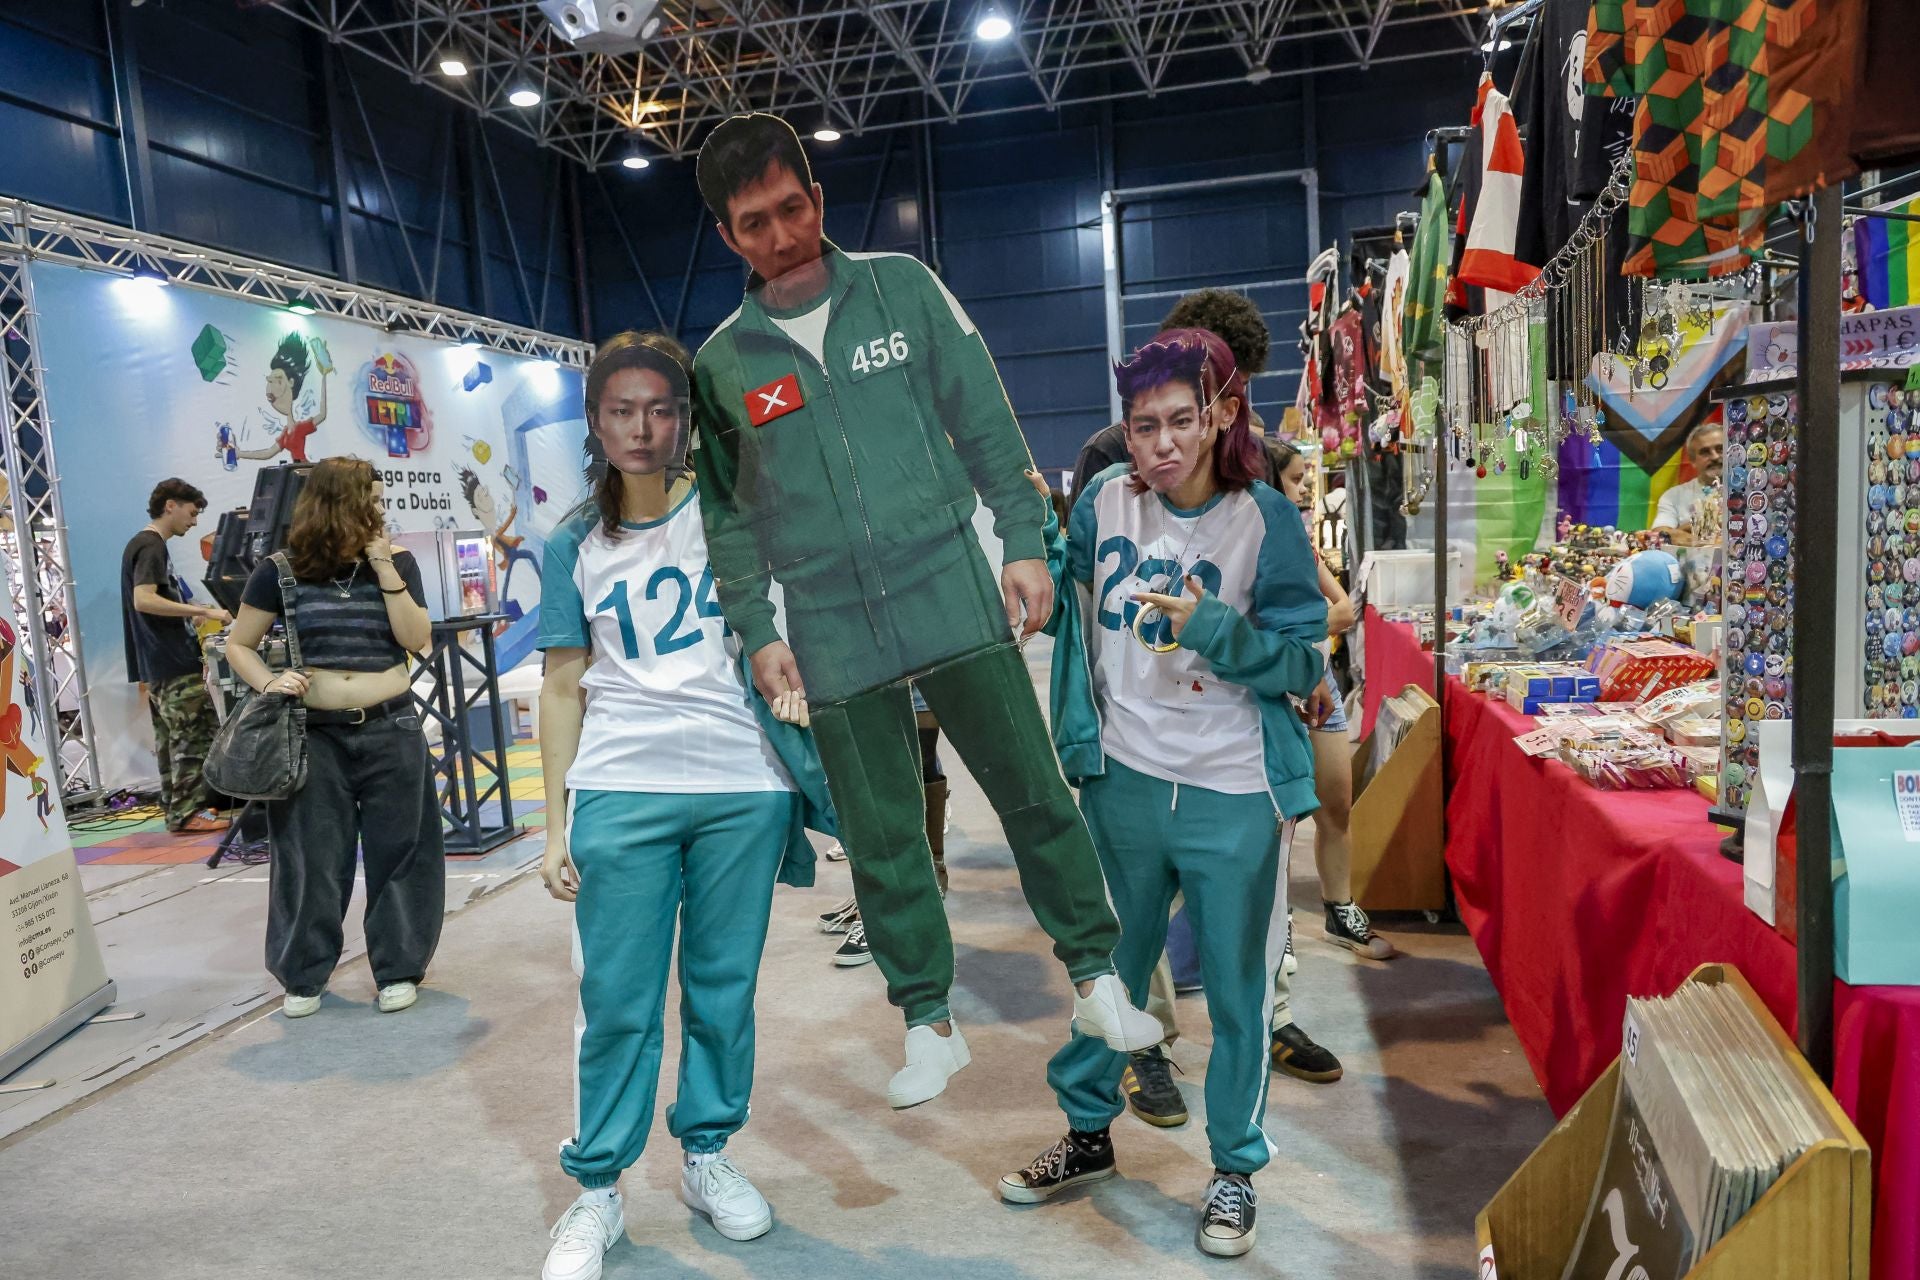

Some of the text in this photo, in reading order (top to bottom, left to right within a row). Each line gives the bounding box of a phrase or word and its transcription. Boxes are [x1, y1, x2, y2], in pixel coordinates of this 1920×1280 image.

[1841, 315, 1913, 336] HAPAS
[852, 331, 910, 375] 456
[377, 470, 441, 488] ega para
[397, 498, 405, 510] a
[410, 492, 451, 510] Dubái
[20, 887, 40, 899] Manuel
